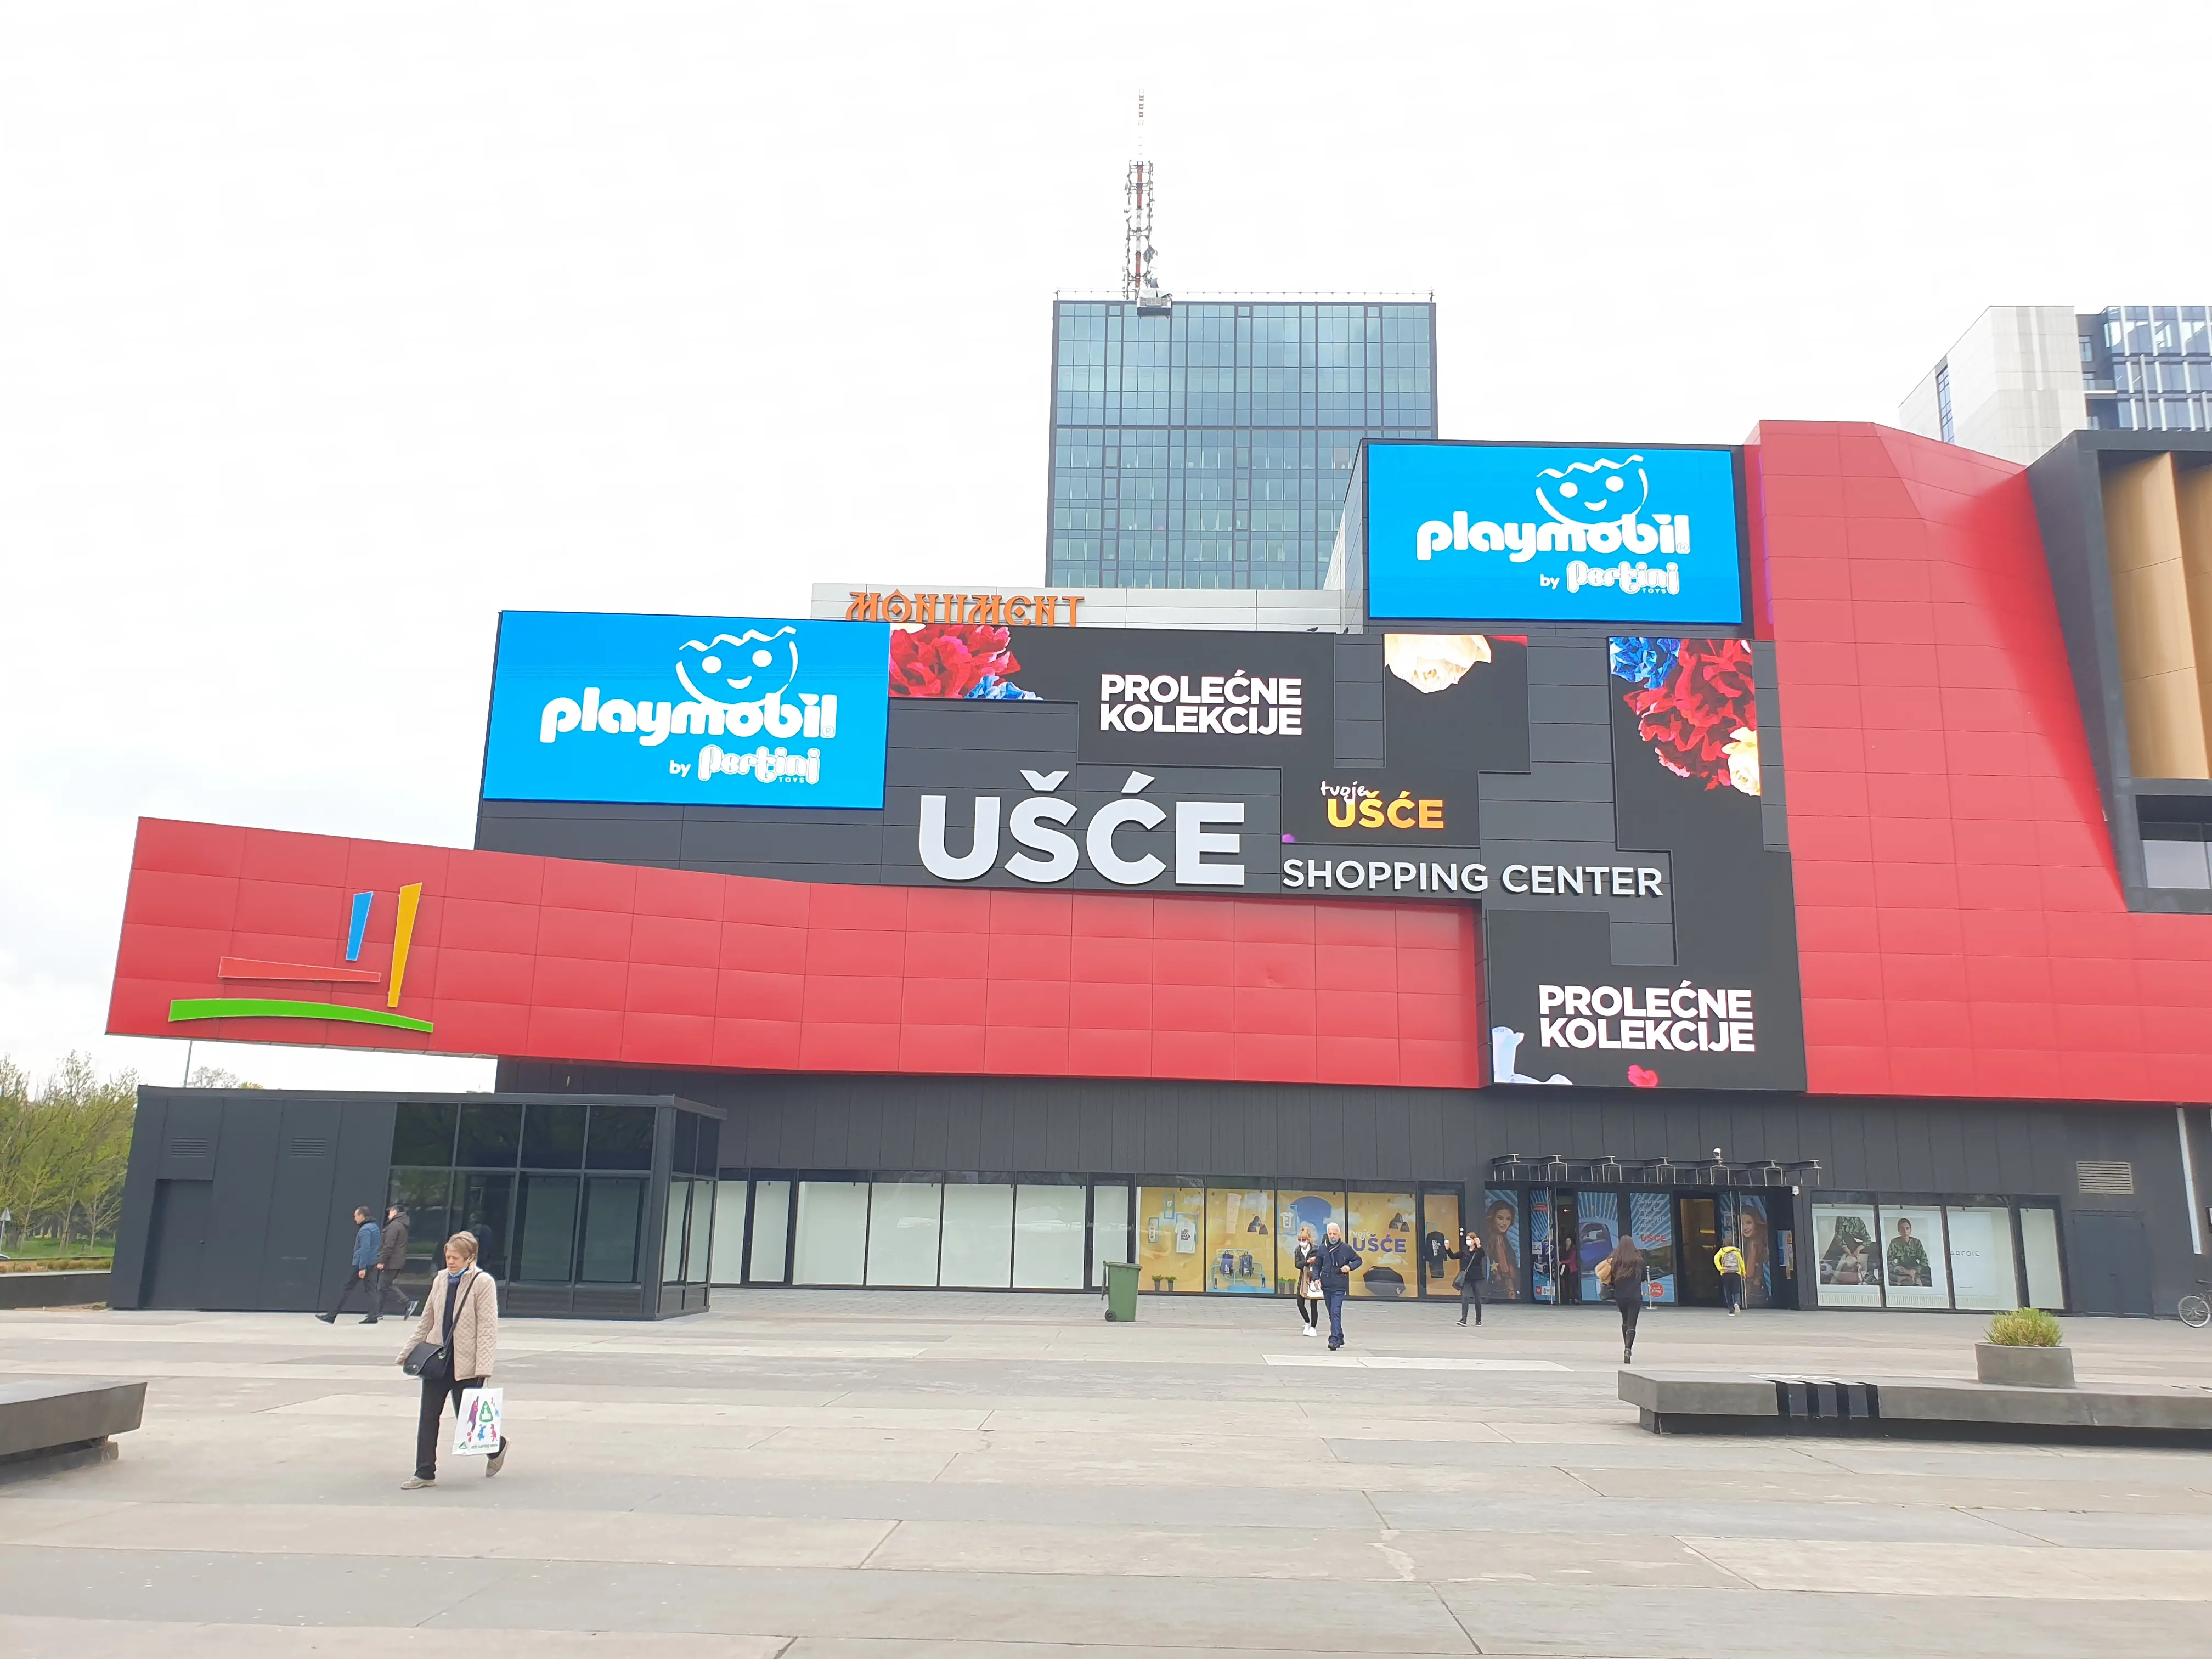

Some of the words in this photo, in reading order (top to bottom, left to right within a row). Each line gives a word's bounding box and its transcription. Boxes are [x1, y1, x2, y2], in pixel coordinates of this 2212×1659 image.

[1417, 511, 1690, 563] playmobil
[1540, 574, 1559, 589] by
[845, 589, 1085, 627] MONUMENT
[1101, 669, 1302, 706] PROLEĆNE
[540, 687, 837, 746] playmobil
[1100, 704, 1302, 735] KOLEKCIJE
[669, 760, 691, 777] by
[1320, 781, 1368, 805] tvoje
[1327, 790, 1444, 828] UŠĆE
[919, 770, 1245, 885] UŠĆE
[1282, 859, 1488, 893] SHOPPING
[1503, 864, 1663, 896] CENTER
[1539, 980, 1753, 1019] PROLEĆNE
[1540, 1017, 1756, 1052] KOLEKCIJE
[1352, 1233, 1406, 1253] UŠĆE
